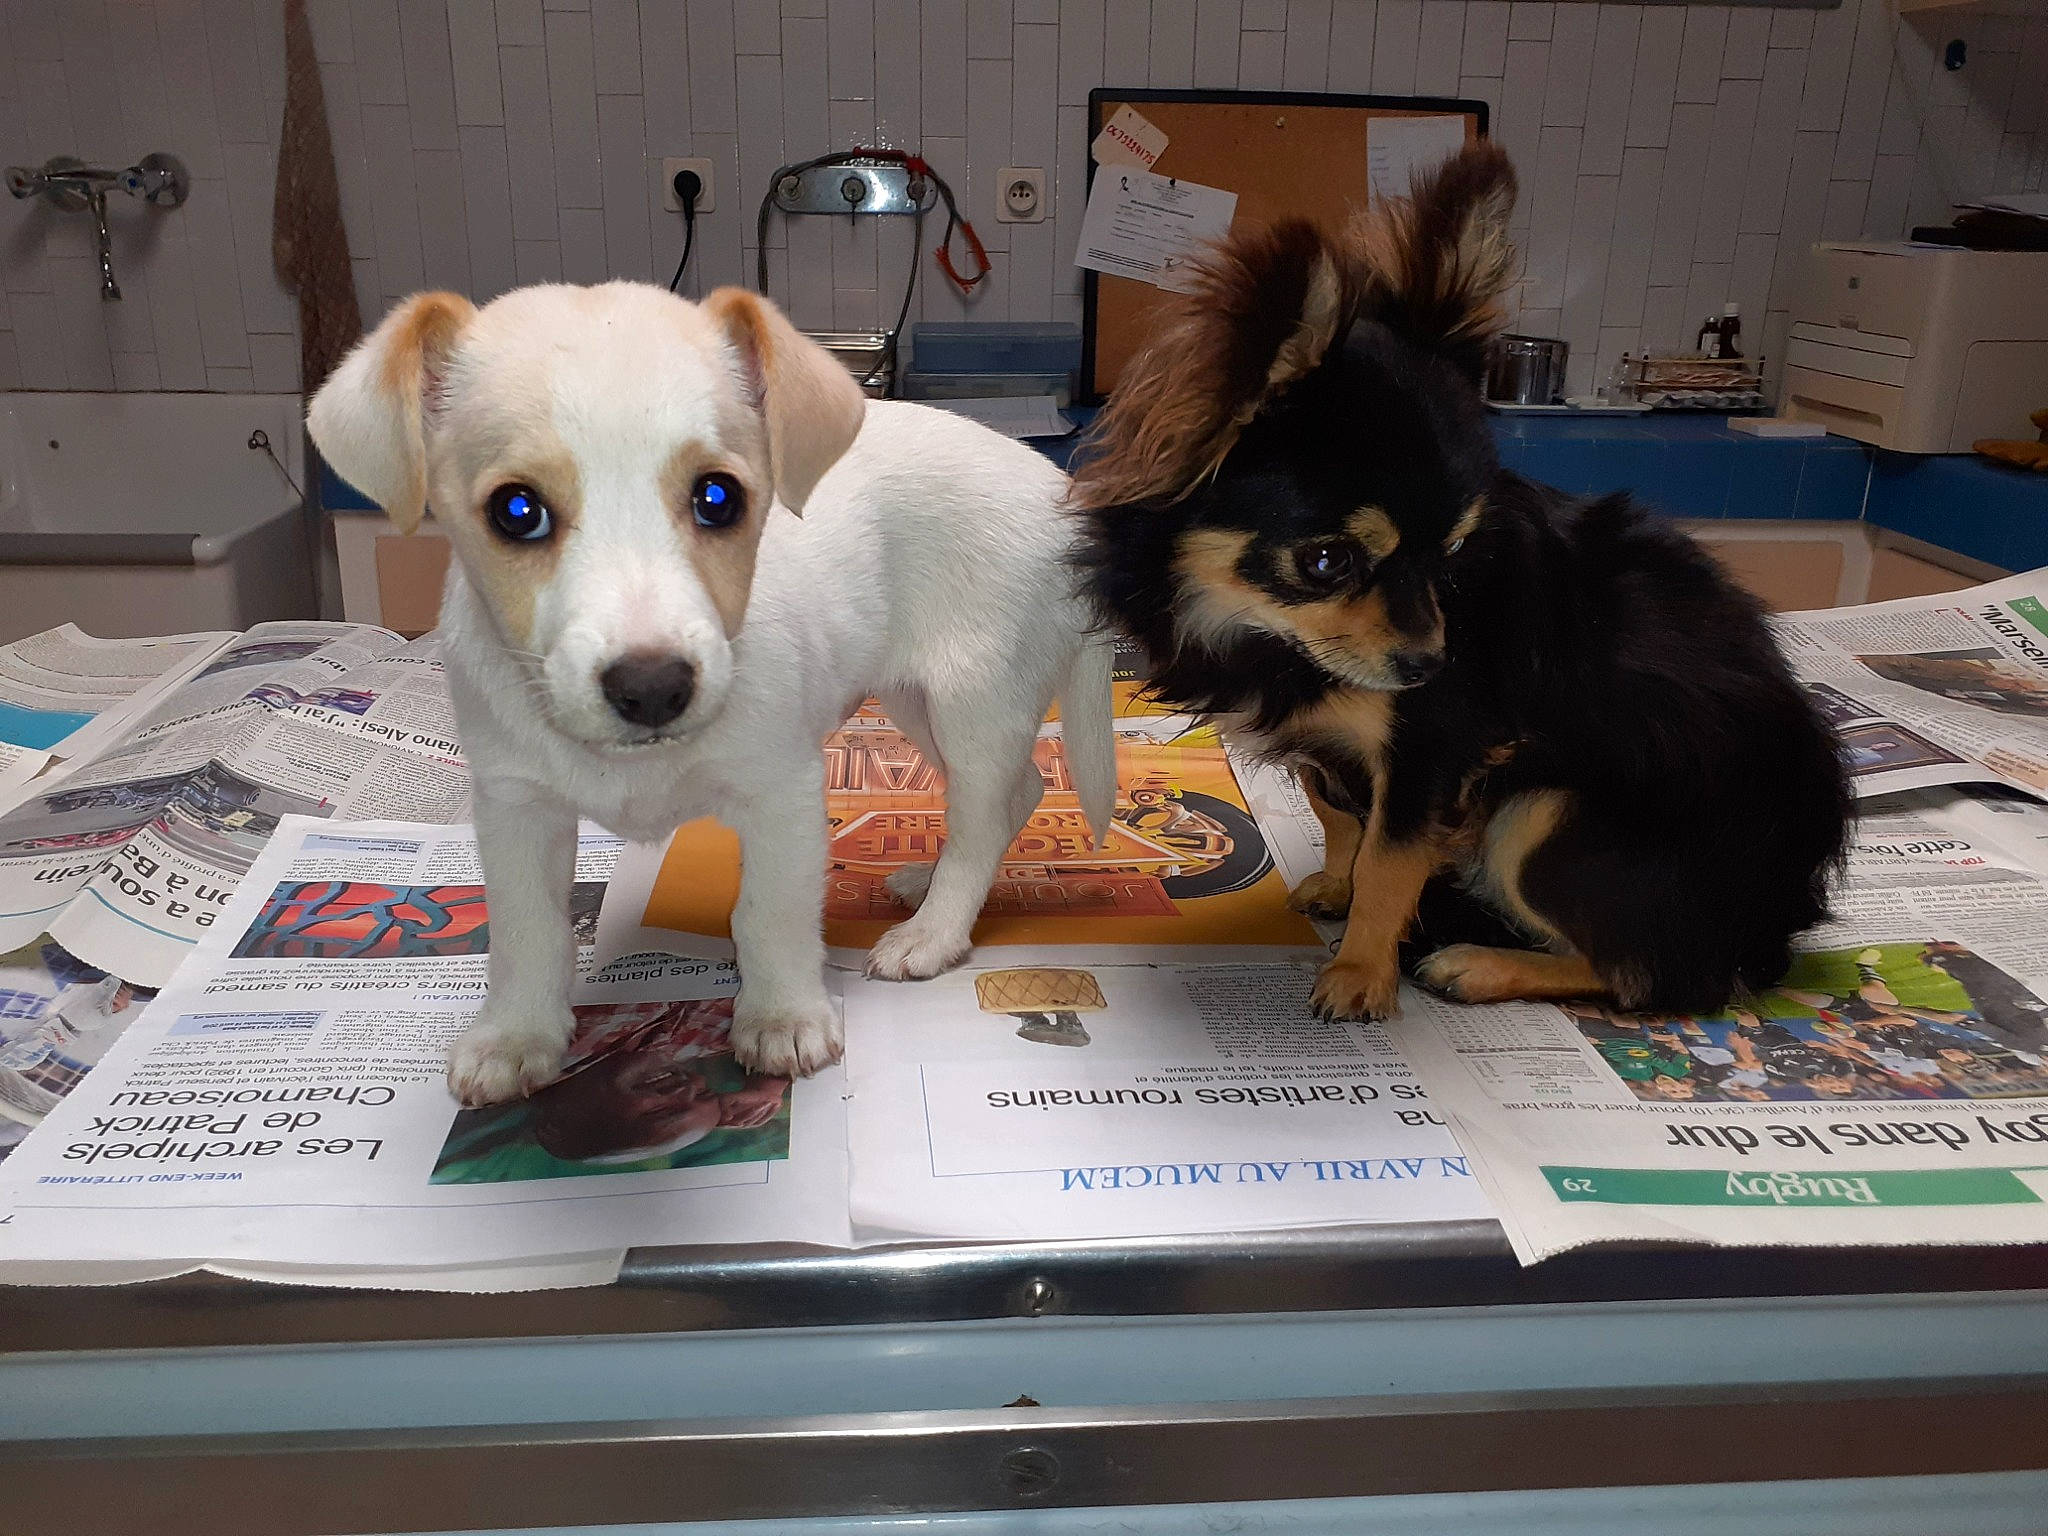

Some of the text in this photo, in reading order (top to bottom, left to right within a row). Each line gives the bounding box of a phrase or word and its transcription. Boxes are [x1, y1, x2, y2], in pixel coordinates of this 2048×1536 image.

[359, 720, 409, 742] Alesi
[412, 734, 462, 757] liano
[172, 858, 216, 878] profité
[165, 900, 190, 919] a
[624, 959, 657, 970] retour
[670, 964, 709, 976] des
[241, 975, 292, 983] nouvelle
[585, 967, 663, 984] plantes
[712, 976, 740, 986] ENT
[203, 983, 288, 995] samedi
[294, 981, 323, 992] du
[329, 981, 410, 992] créatifs
[235, 1058, 290, 1066] lectures
[371, 1057, 389, 1065] de
[169, 1068, 203, 1076] pour
[267, 1067, 333, 1075] Goncourt
[370, 1066, 447, 1075] hamoiseau
[1223, 1065, 1235, 1073] le
[1239, 1065, 1256, 1073] tel
[1307, 1063, 1370, 1071] différents
[130, 1070, 167, 1078] deux
[316, 1075, 353, 1083] invite
[1217, 1074, 1268, 1082] notions
[1271, 1073, 1293, 1081] les
[1295, 1071, 1370, 1081] questionne
[124, 1079, 173, 1088] Patrick
[175, 1077, 234, 1086] penseur
[355, 1075, 408, 1084] Mucem
[411, 1076, 429, 1084] Le
[1134, 1076, 1148, 1085] et
[1152, 1075, 1214, 1084] d'identité
[108, 1086, 396, 1108] Chamoiseau
[987, 1088, 1183, 1111] roumains
[1195, 1085, 1378, 1108] d'artistes
[1502, 1102, 1541, 1112] bras
[1541, 1101, 1576, 1111] gros
[1579, 1102, 1603, 1112] les
[1604, 1103, 1646, 1115] jouer
[1648, 1104, 1687, 1115] pour
[1826, 1104, 1859, 1114] côté
[1860, 1104, 1885, 1114] du
[82, 1112, 322, 1137] de Patrick
[1665, 1124, 1759, 1155] dur
[1765, 1125, 1834, 1155] le
[1828, 1122, 1970, 1151] dans
[61, 1137, 384, 1165] Les archipels
[36, 1172, 244, 1185] WEEK-END LITTÉRAIRE
[1060, 1157, 1471, 1192] N AVRIL AU MUCEM
[1563, 1171, 1880, 1205] Rugby 29
